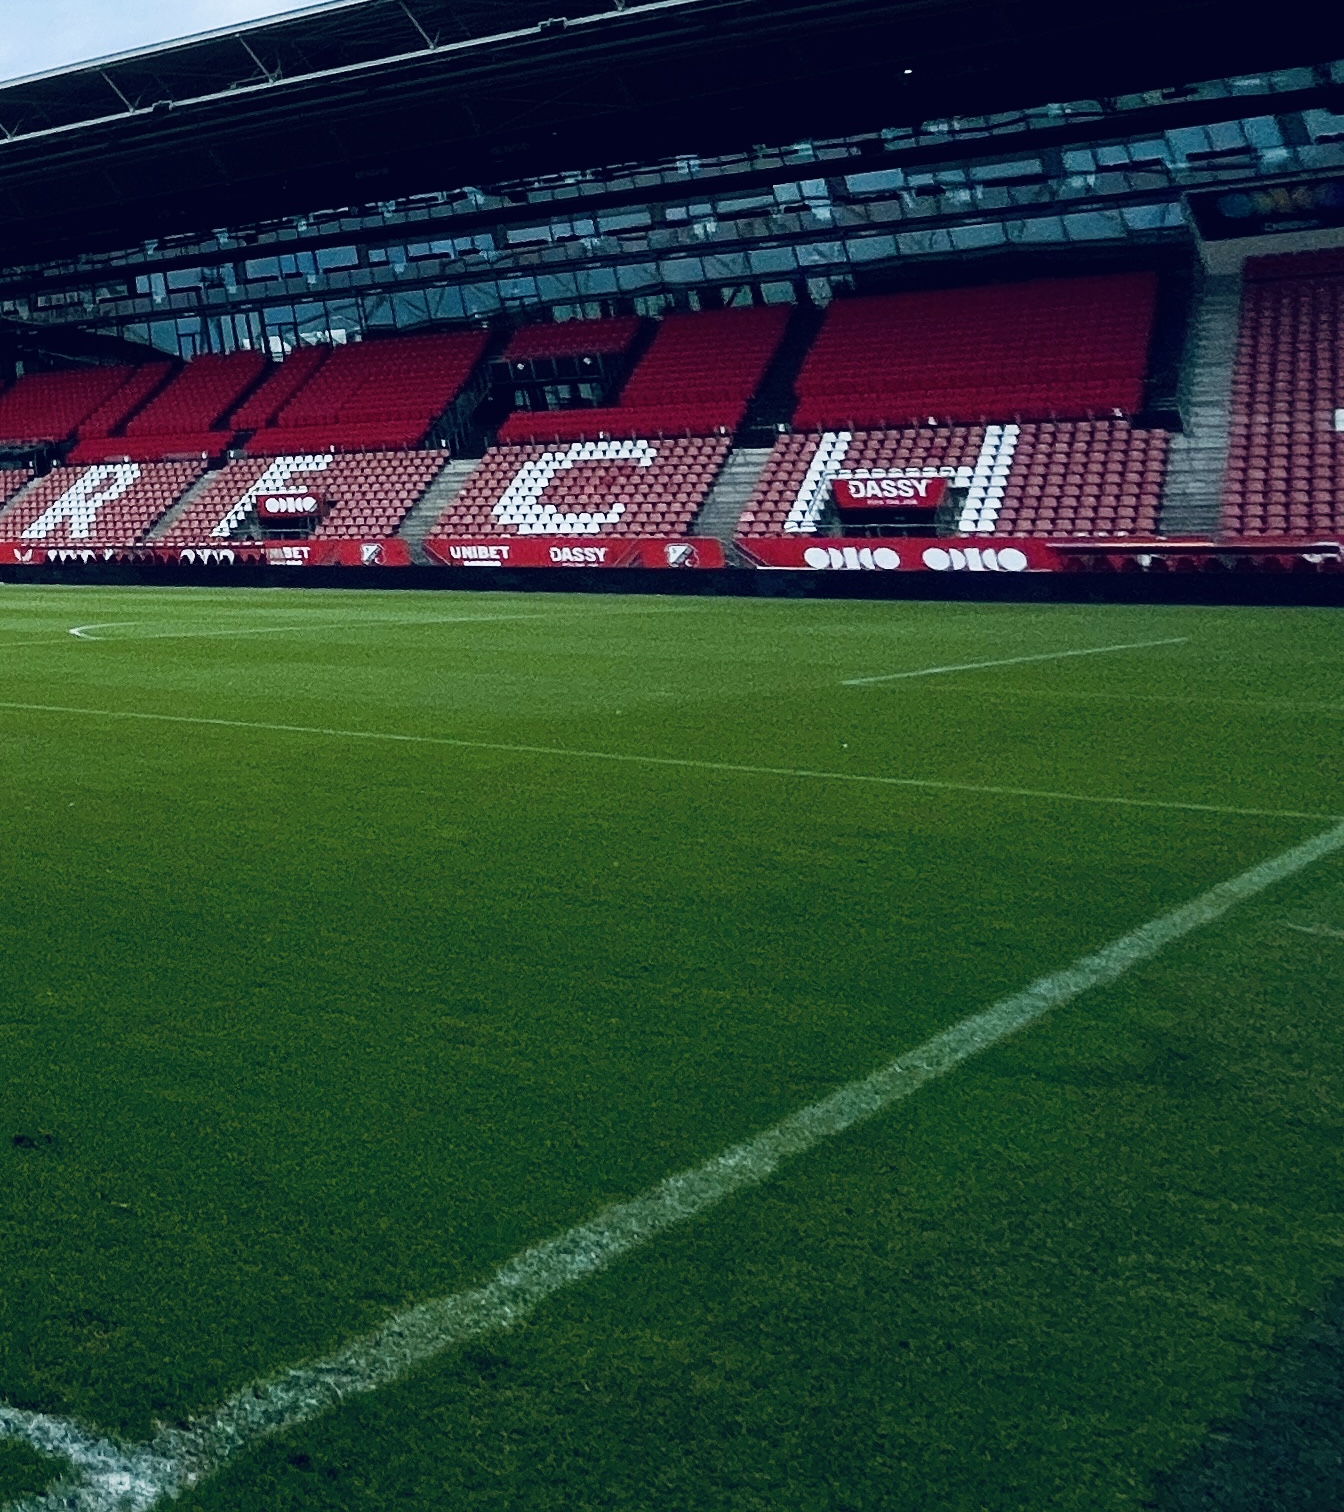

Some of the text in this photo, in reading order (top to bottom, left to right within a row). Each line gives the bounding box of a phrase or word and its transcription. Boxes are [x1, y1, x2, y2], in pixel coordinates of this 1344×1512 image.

[848, 480, 932, 498] DASSY
[450, 546, 509, 560] UNIBET
[549, 547, 608, 562] DASSY
